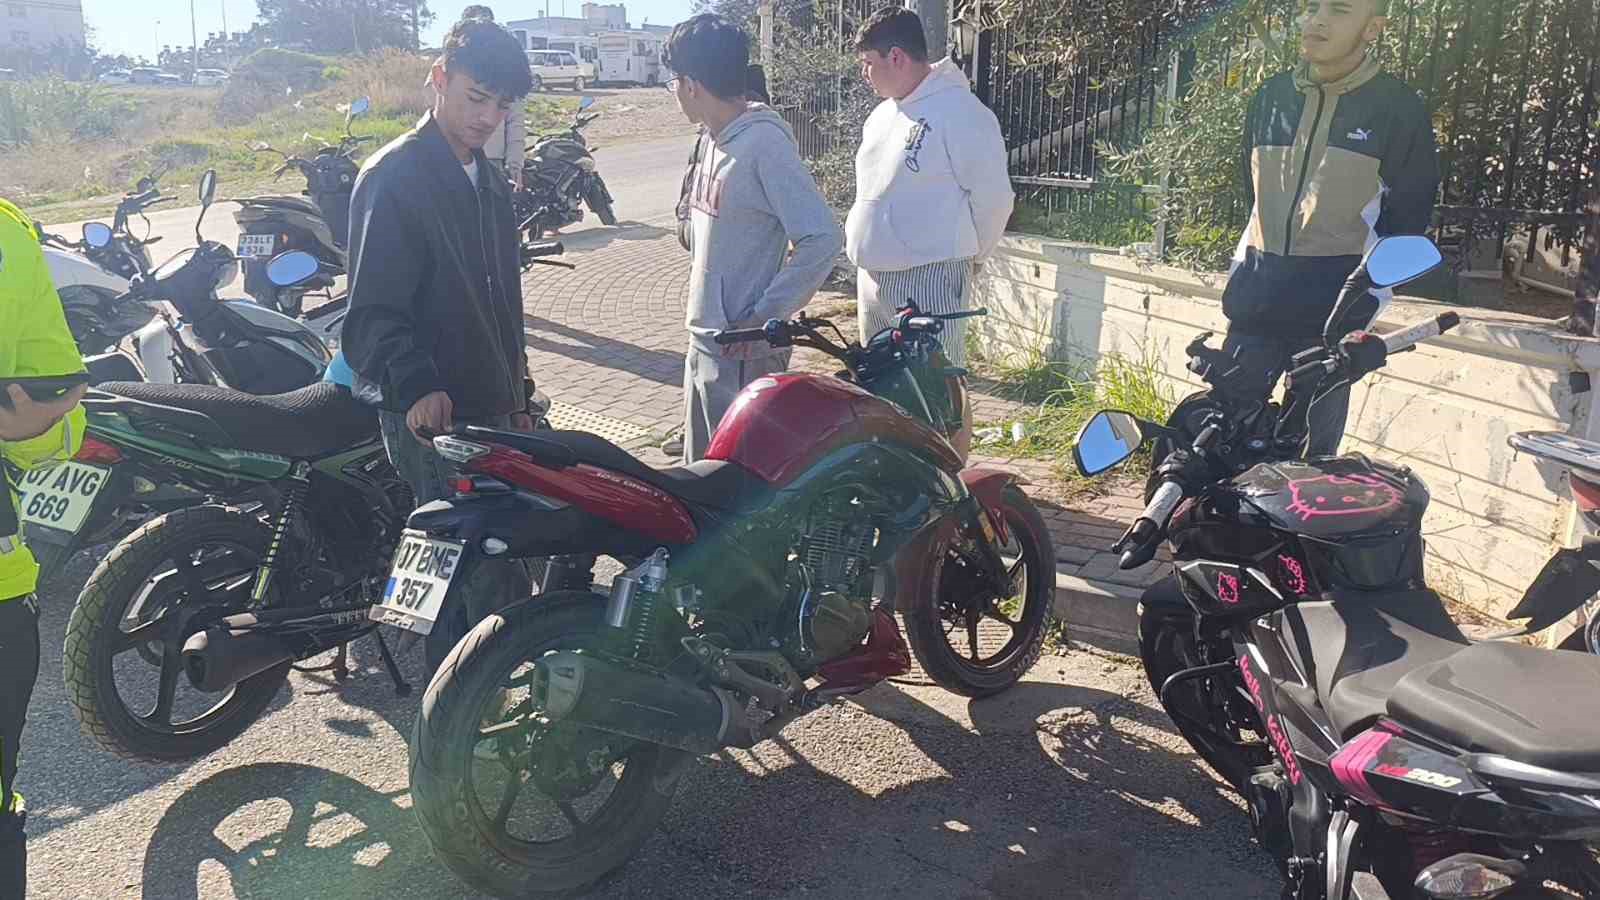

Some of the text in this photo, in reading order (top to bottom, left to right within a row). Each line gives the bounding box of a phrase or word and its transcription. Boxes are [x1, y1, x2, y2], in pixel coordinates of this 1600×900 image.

[51, 465, 100, 497] AVG
[26, 492, 70, 522] 669
[397, 541, 460, 580] 07 BME
[396, 578, 433, 610] 357
